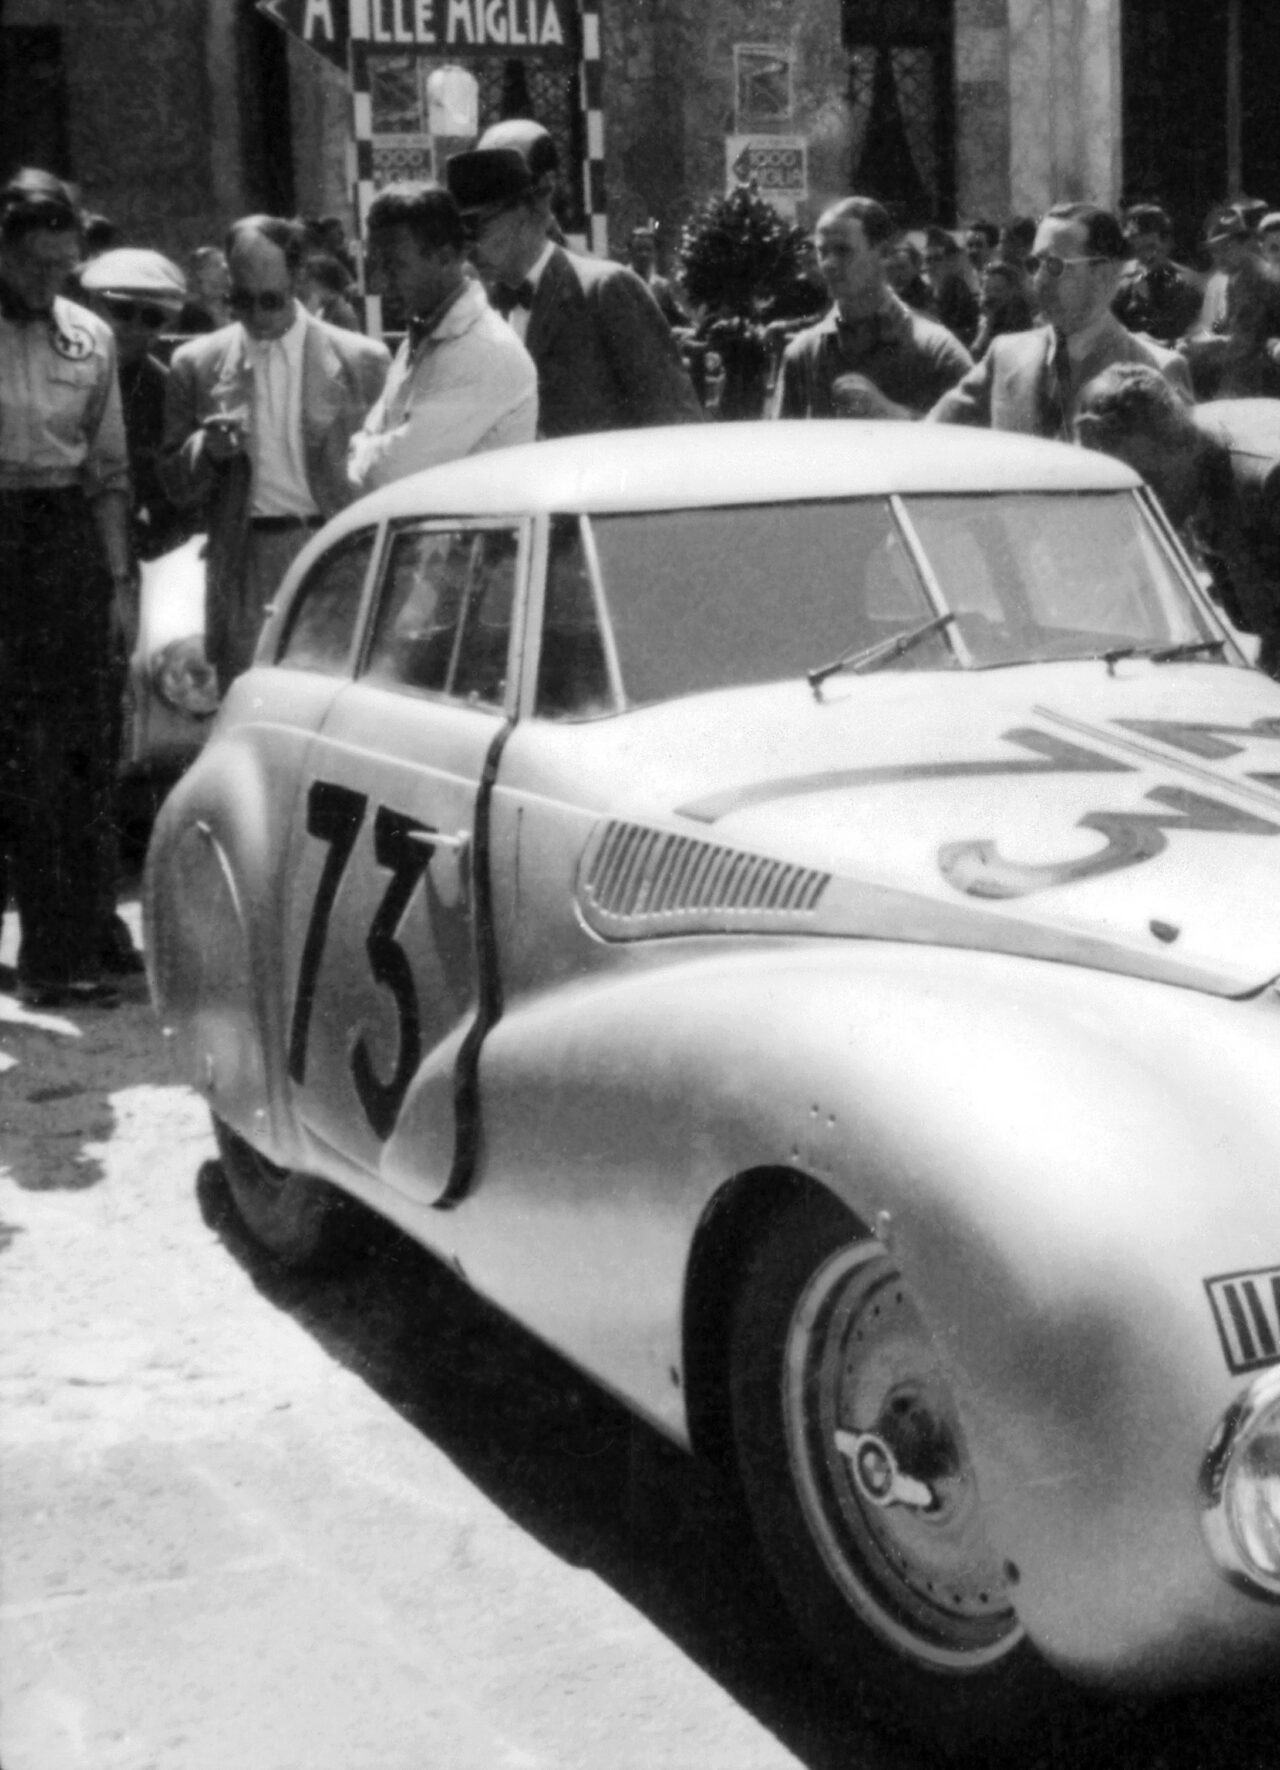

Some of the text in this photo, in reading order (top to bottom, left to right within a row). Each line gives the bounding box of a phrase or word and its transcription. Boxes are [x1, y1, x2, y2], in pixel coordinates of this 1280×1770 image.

[303, 0, 564, 45] MLLE MIGLIA
[289, 779, 439, 1143] 73
